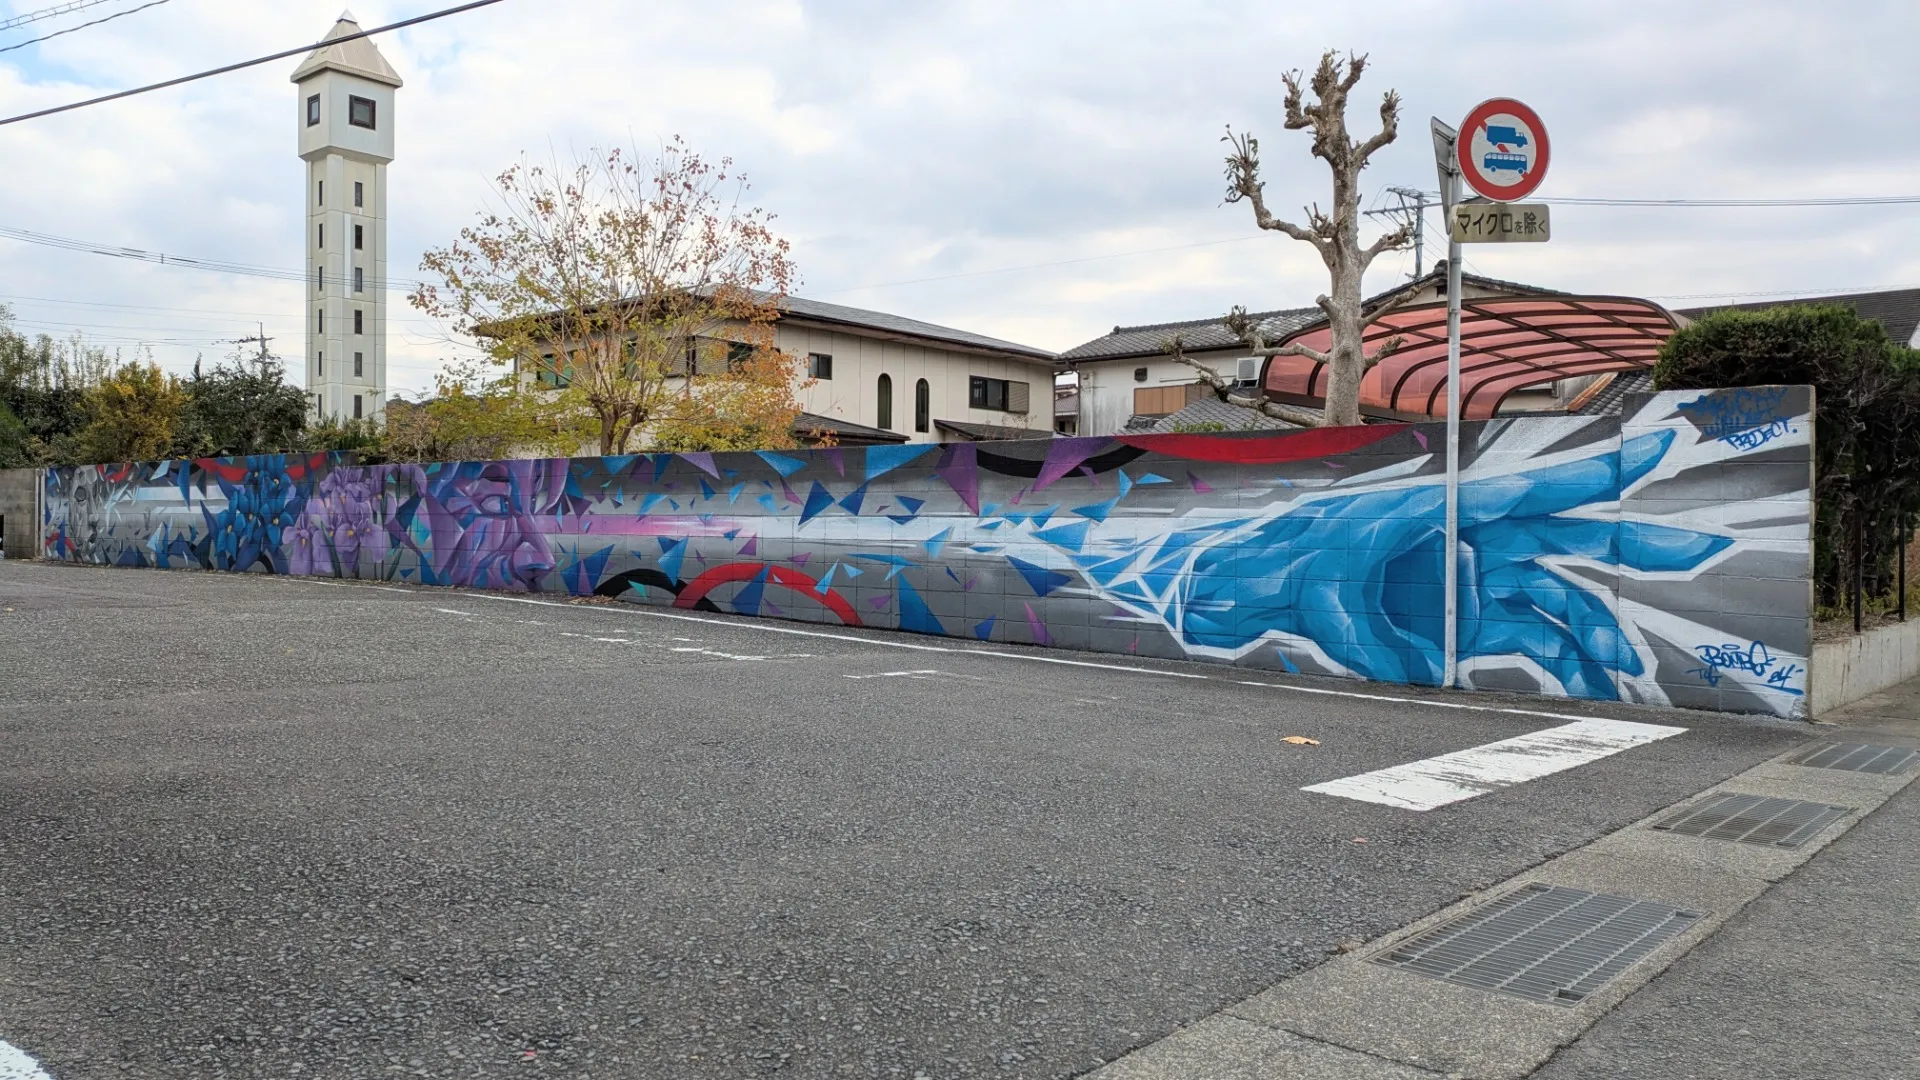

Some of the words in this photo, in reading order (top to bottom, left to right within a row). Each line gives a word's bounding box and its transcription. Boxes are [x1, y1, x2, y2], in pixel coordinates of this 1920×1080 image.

[1457, 212, 1546, 235] マイクロを除く
